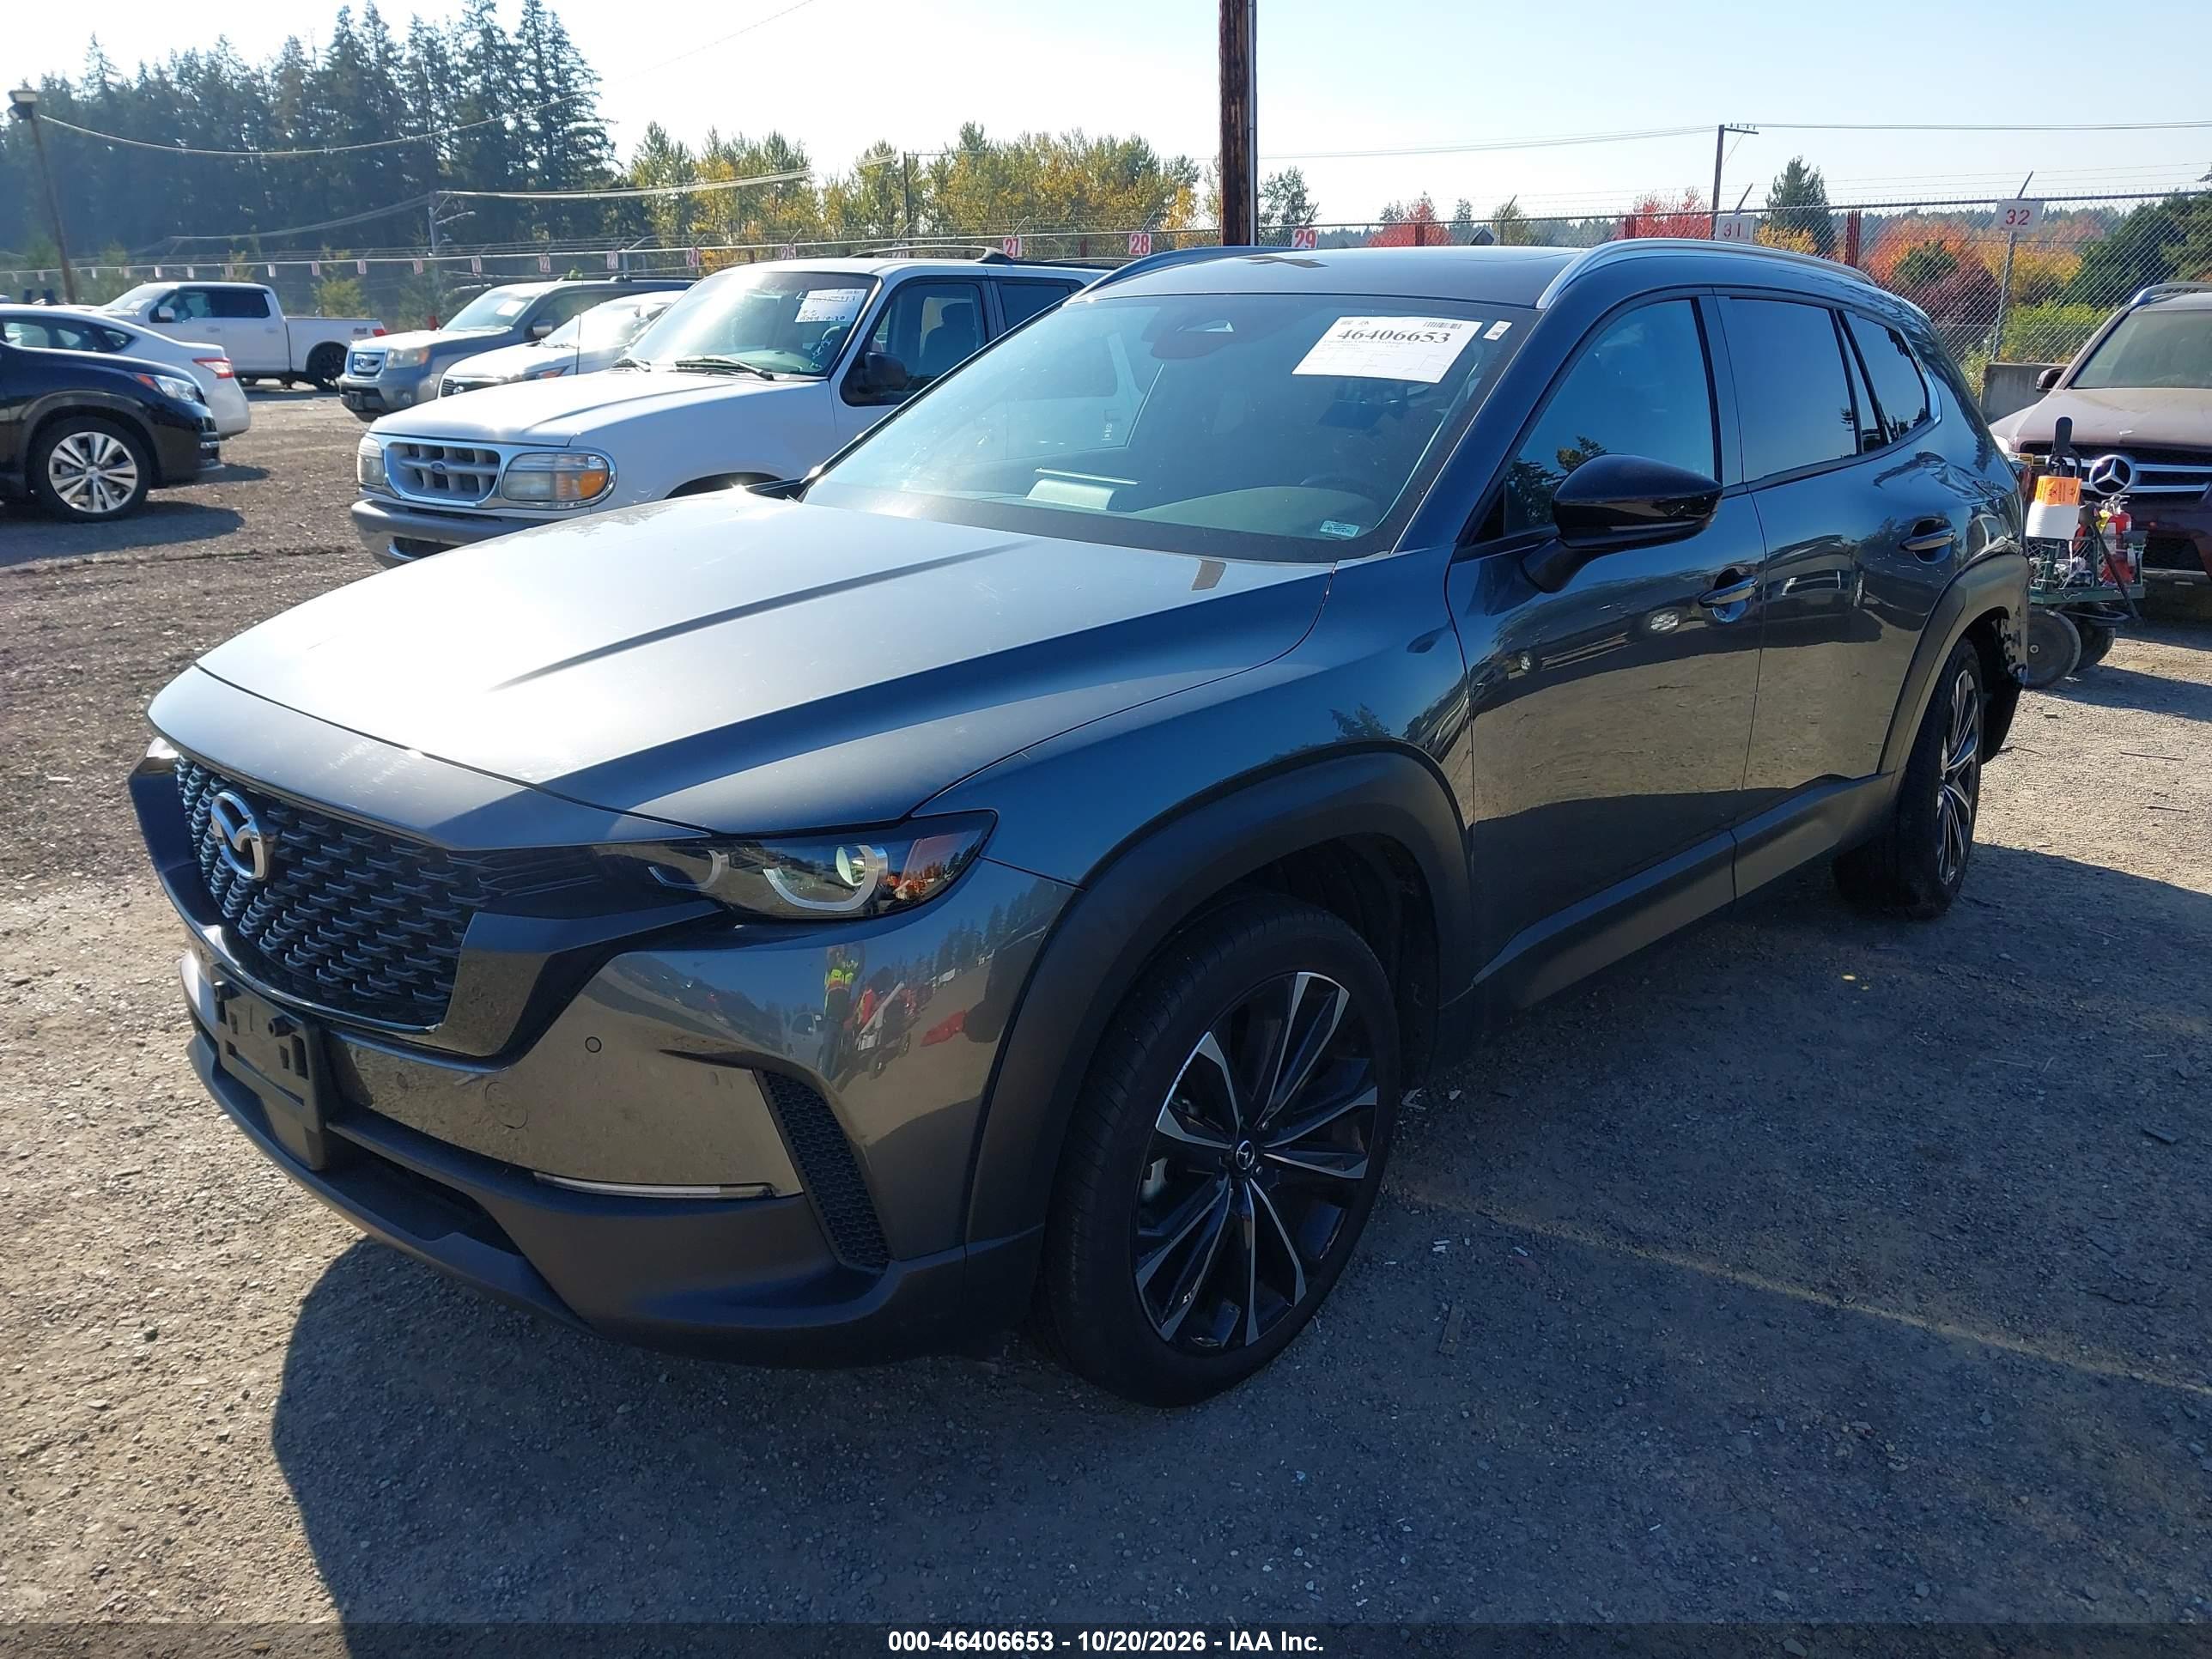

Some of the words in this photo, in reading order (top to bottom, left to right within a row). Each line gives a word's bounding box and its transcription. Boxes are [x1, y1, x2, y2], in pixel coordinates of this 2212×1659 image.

[2006, 209, 2030, 225] 32
[1723, 222, 1741, 237] 31
[1131, 234, 1150, 255] 28
[1294, 229, 1316, 248] 29
[1006, 238, 1019, 256] 27
[688, 250, 698, 265] 24
[1337, 329, 1450, 343] 46406653
